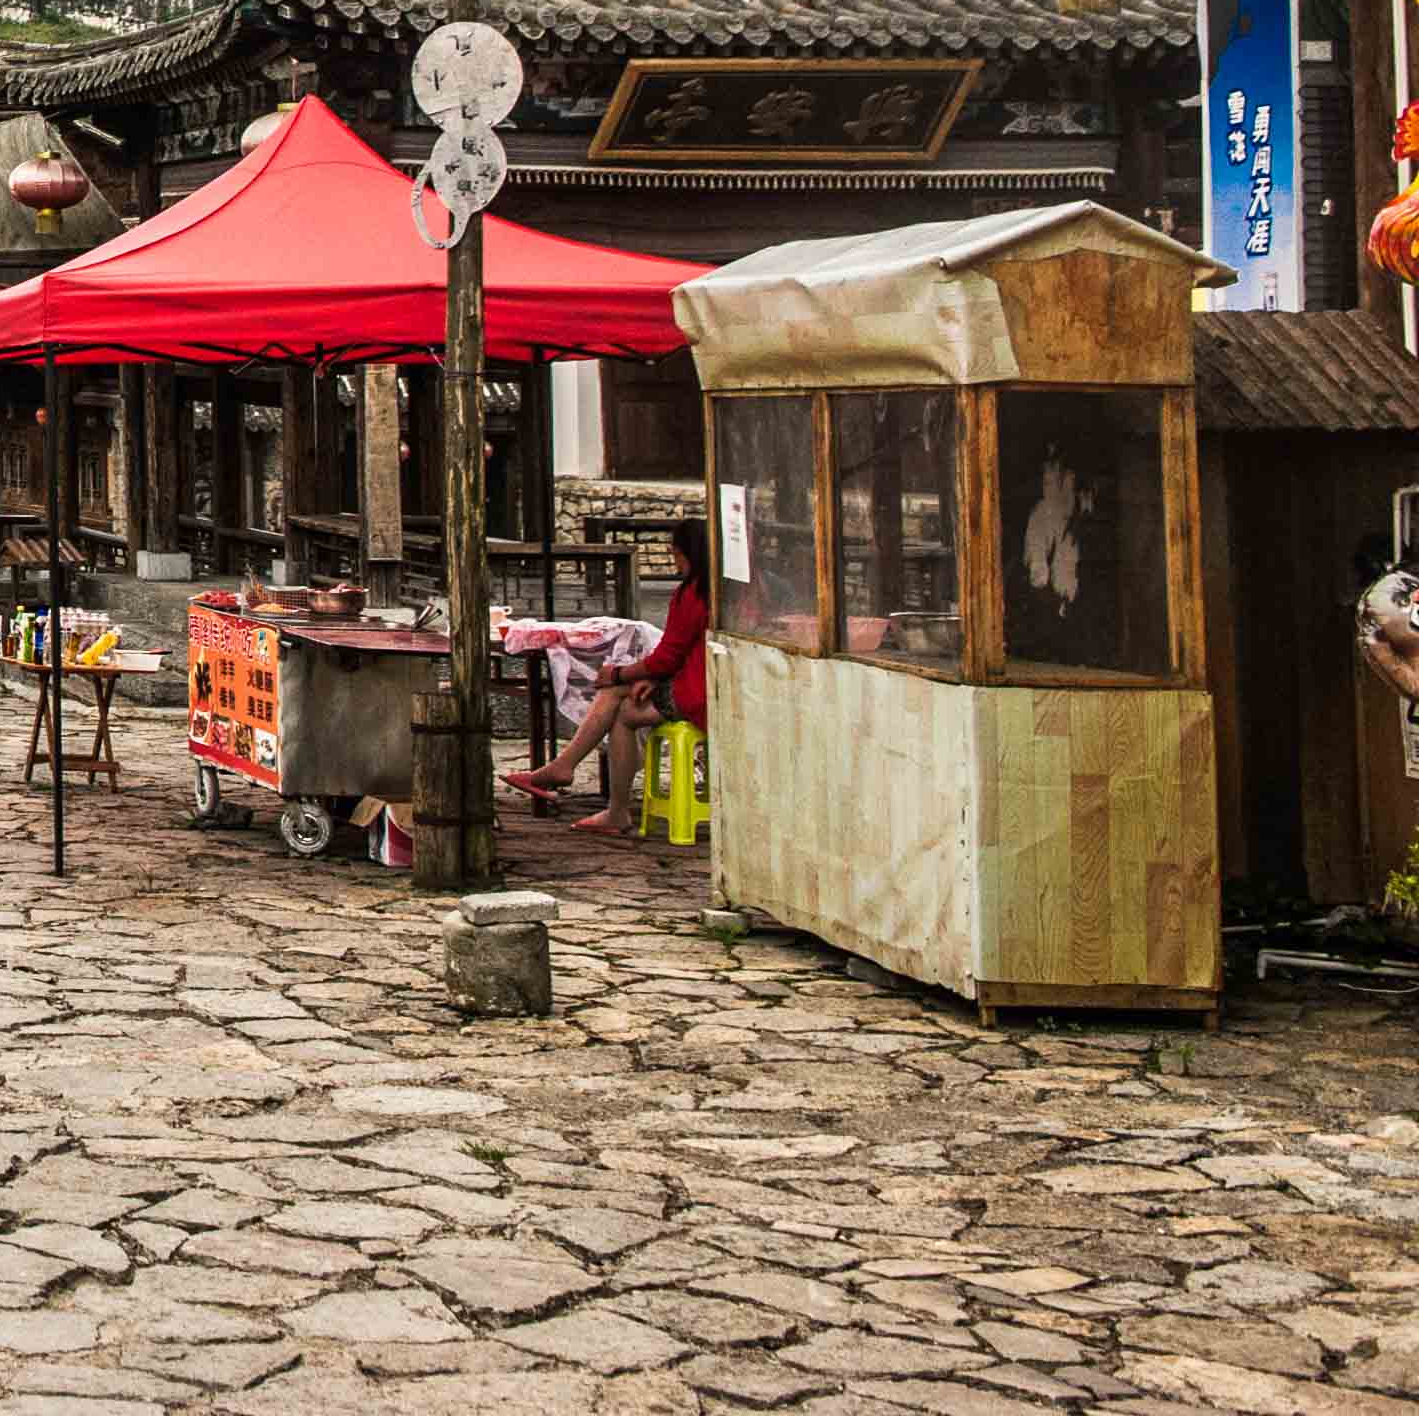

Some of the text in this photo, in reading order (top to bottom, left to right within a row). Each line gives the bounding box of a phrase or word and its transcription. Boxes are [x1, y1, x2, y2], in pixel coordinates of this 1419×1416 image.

[1226, 90, 1246, 163] 雪花
[1247, 105, 1271, 255] 勇闯天涯
